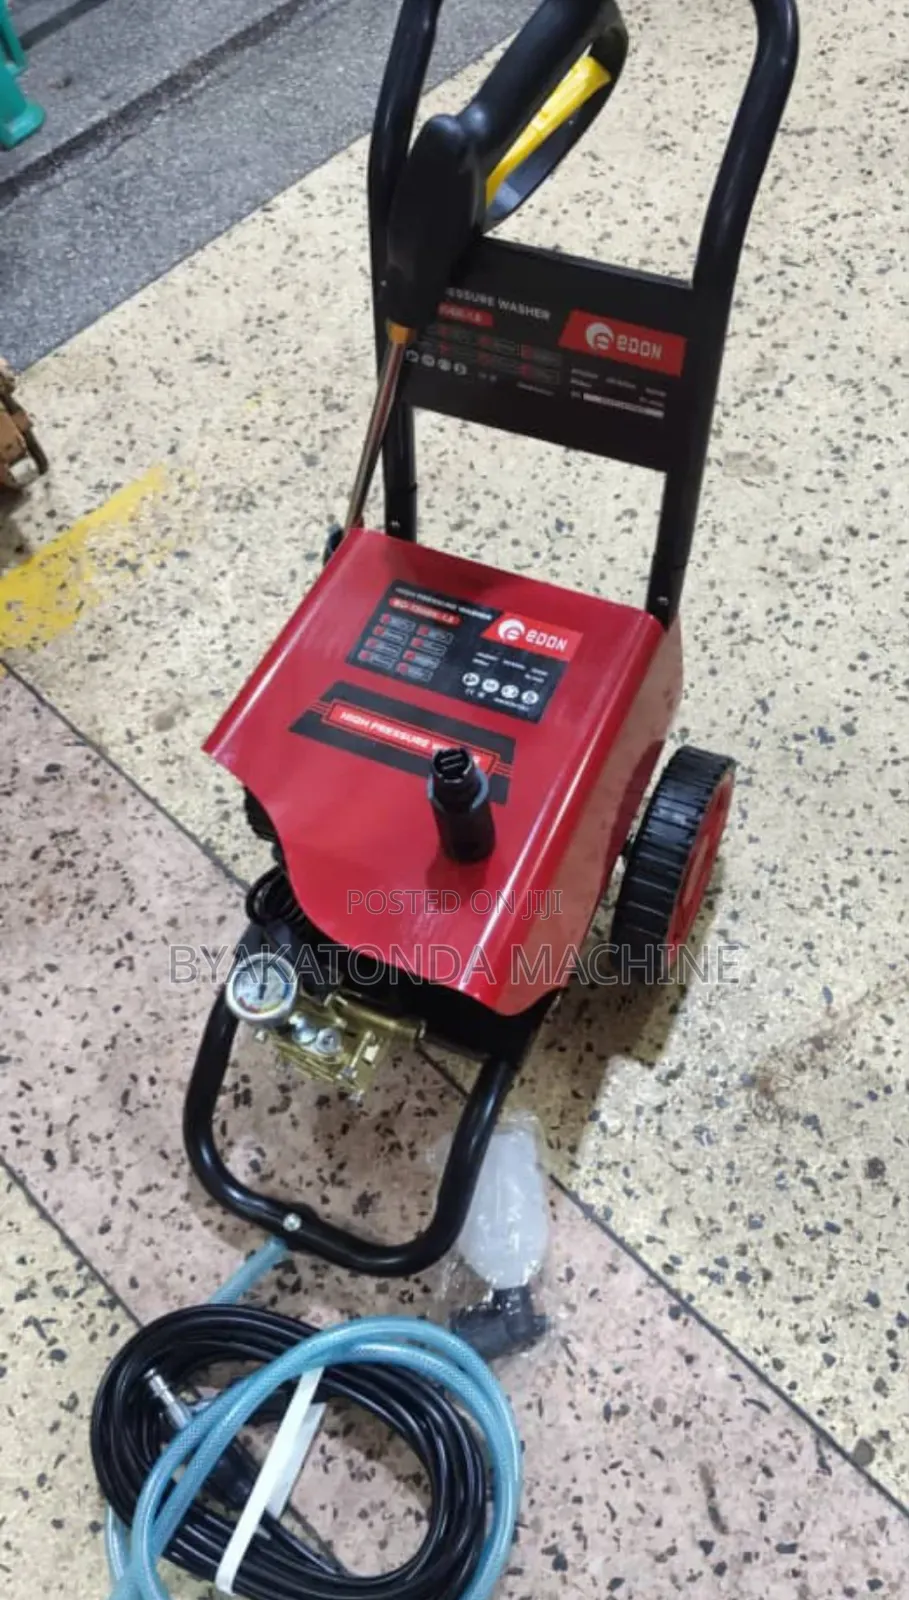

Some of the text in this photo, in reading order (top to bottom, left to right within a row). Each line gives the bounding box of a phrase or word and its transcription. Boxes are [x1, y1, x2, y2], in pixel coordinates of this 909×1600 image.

[498, 300, 551, 321] WASHER
[339, 711, 430, 748] HIGH PRESSURE
